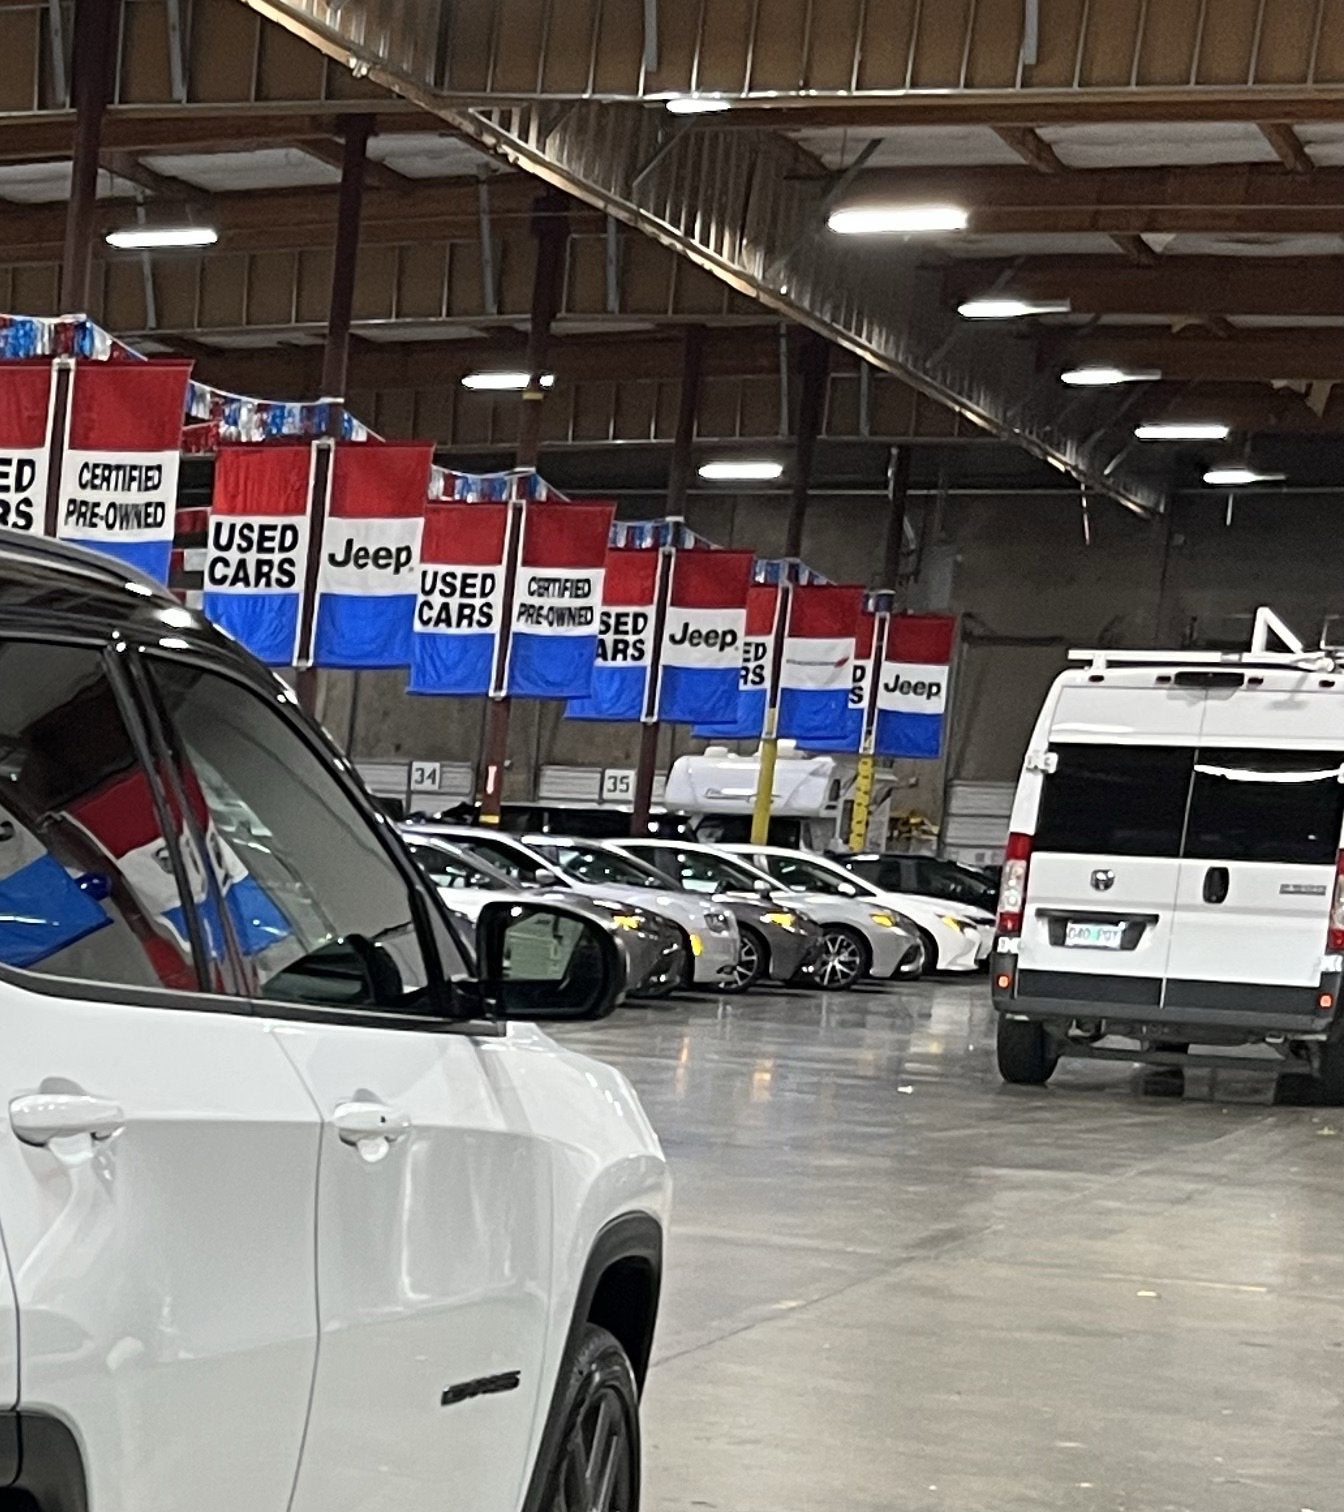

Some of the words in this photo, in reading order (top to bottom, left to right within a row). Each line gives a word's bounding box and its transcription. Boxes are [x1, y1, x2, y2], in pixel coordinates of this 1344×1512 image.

[78, 461, 163, 493] CERTIFIED
[64, 498, 166, 531] PRE-OWNED
[212, 521, 299, 554] USED
[327, 537, 413, 575] Jeep
[208, 555, 296, 588] CARS
[420, 570, 496, 599] USED
[527, 576, 592, 599] CERTIFIED
[417, 600, 494, 628] CARS
[516, 603, 594, 628] PRE-OWNED
[598, 611, 648, 636] SED
[596, 638, 646, 662] ARS
[668, 621, 738, 652] Jeep
[883, 673, 942, 700] Jeep
[414, 766, 438, 785] 34
[606, 774, 631, 794] 35
